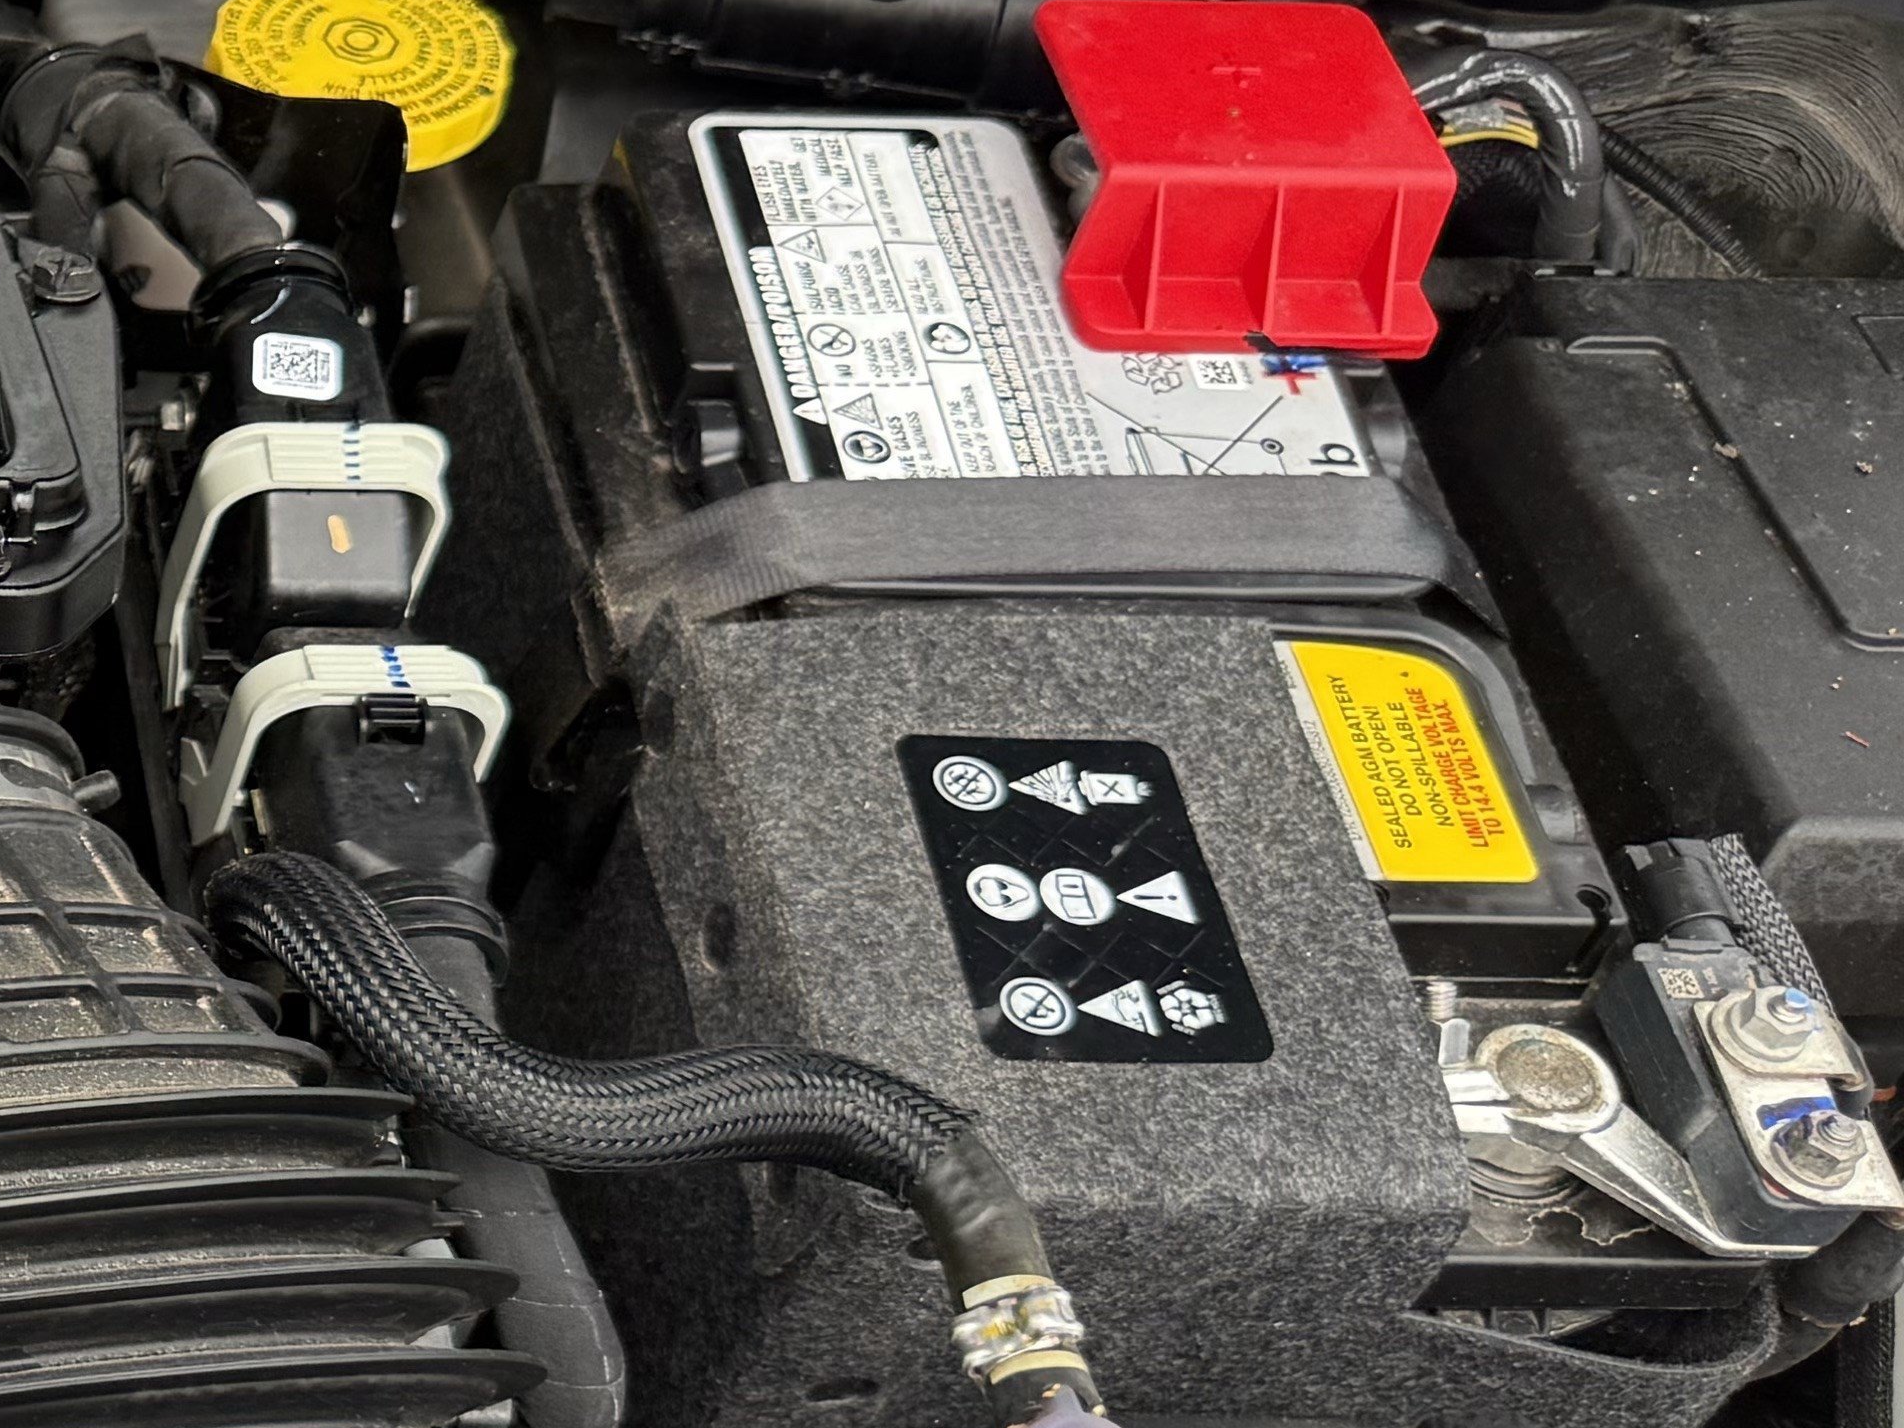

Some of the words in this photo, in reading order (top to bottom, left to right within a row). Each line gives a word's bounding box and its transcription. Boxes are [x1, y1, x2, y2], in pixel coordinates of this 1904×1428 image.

[746, 247, 818, 397] DANGER/POISON
[1325, 674, 1369, 742] BATTERY
[1360, 705, 1396, 752] OPEN!
[1403, 687, 1446, 746] VOLTAGE
[1430, 698, 1460, 732] MAX.
[1355, 747, 1385, 782] AGM
[1381, 757, 1411, 788] NOT
[1385, 702, 1454, 826] NON-SPILLABLE
[1431, 751, 1471, 805] CHARGE
[1446, 738, 1481, 780] VOLTS
[1370, 785, 1413, 848] SEALED
[1397, 793, 1423, 815] DO
[1467, 784, 1496, 813] 14.4
[1457, 809, 1489, 847] LIMIT
[1481, 817, 1505, 834] TO
